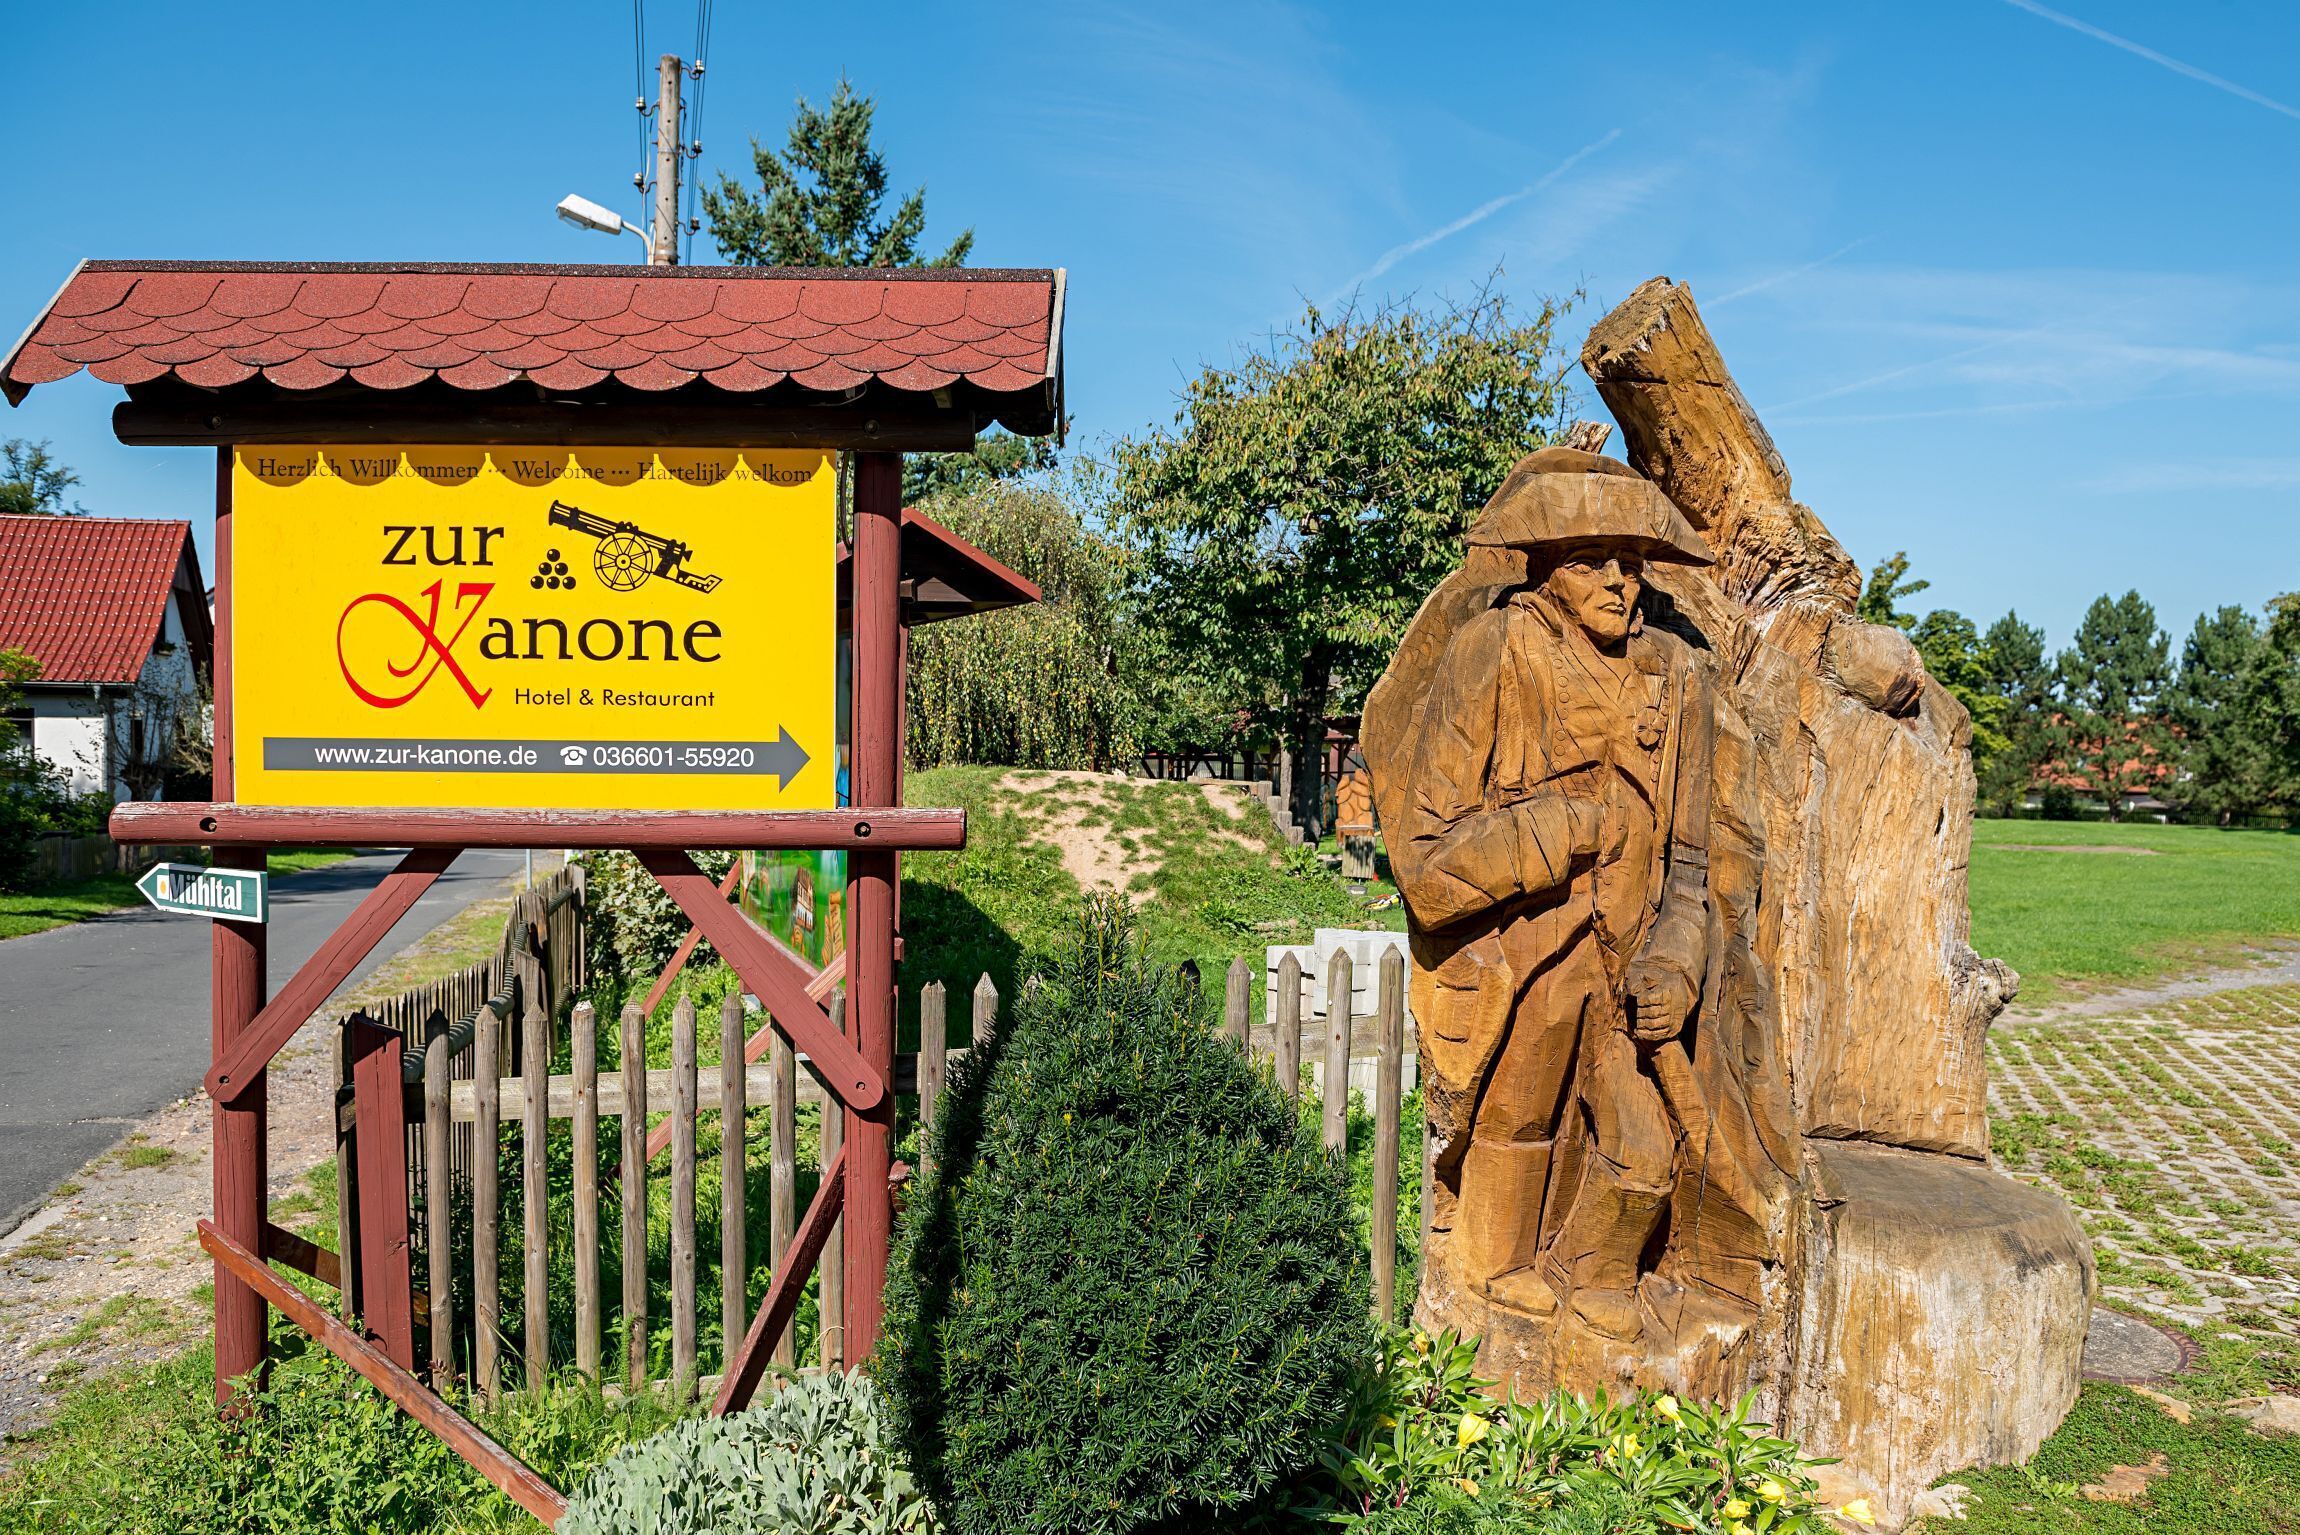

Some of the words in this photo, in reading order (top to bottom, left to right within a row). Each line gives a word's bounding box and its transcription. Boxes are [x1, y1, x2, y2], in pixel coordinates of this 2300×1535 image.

[257, 458, 342, 478] Herzlich
[350, 459, 480, 479] Willkommen
[512, 460, 605, 480] Welcome
[637, 461, 727, 485] Hartelijk
[735, 464, 813, 482] welkom
[382, 525, 504, 566] zur
[336, 578, 722, 710] Kanone
[515, 688, 571, 706] Hotel
[580, 689, 594, 706] &
[603, 688, 715, 707] Restaurant
[314, 745, 538, 766] www.zur-kanone.de
[593, 746, 755, 768] 036601-55920
[169, 873, 242, 911] Mühltal
